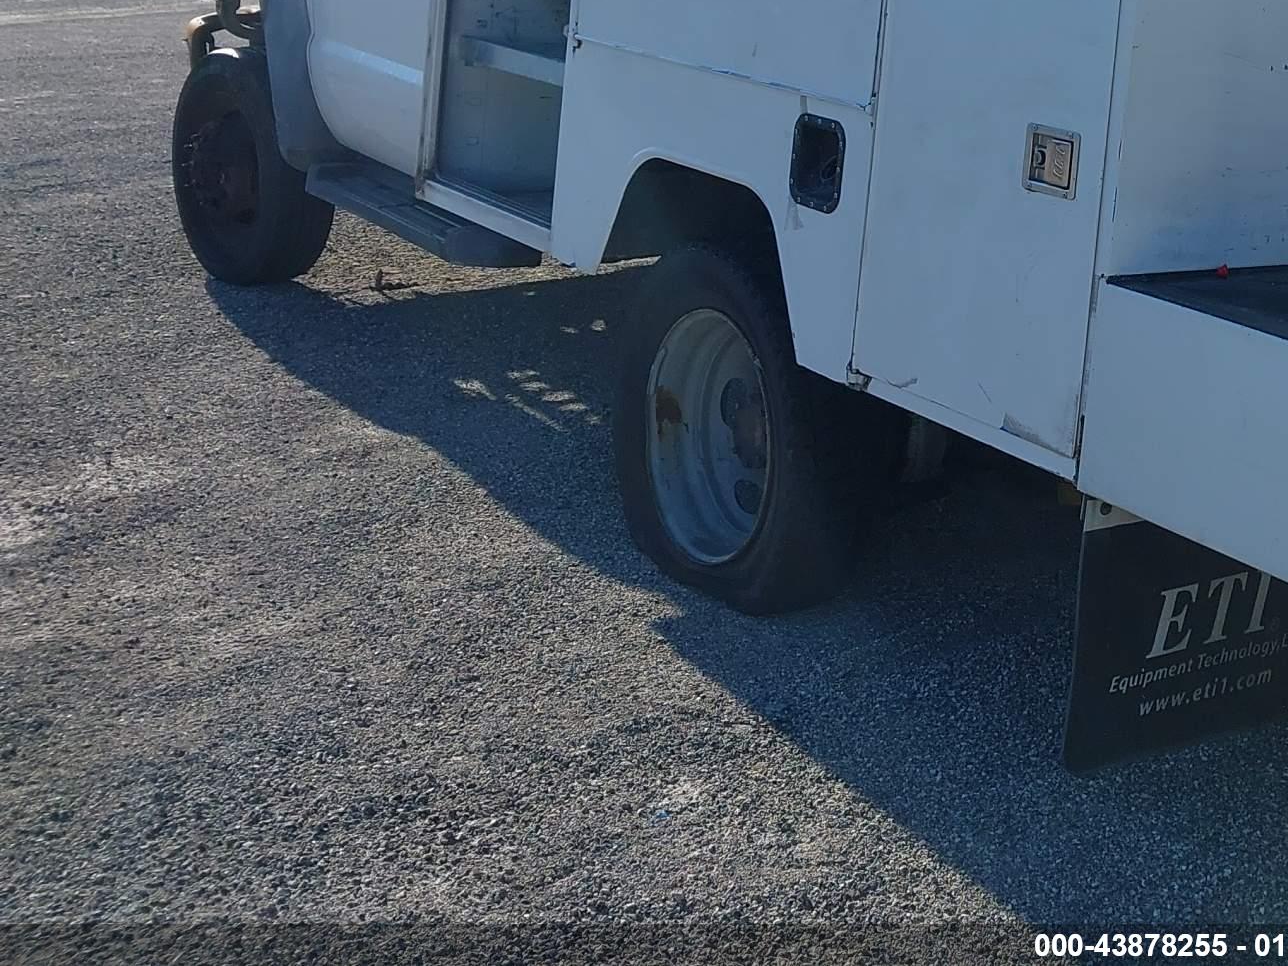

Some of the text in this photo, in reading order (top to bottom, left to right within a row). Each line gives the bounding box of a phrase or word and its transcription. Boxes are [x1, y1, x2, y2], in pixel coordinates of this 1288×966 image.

[1145, 571, 1272, 659] ETI
[1108, 658, 1193, 694] Equipment
[1138, 669, 1272, 717] www.eti1.com
